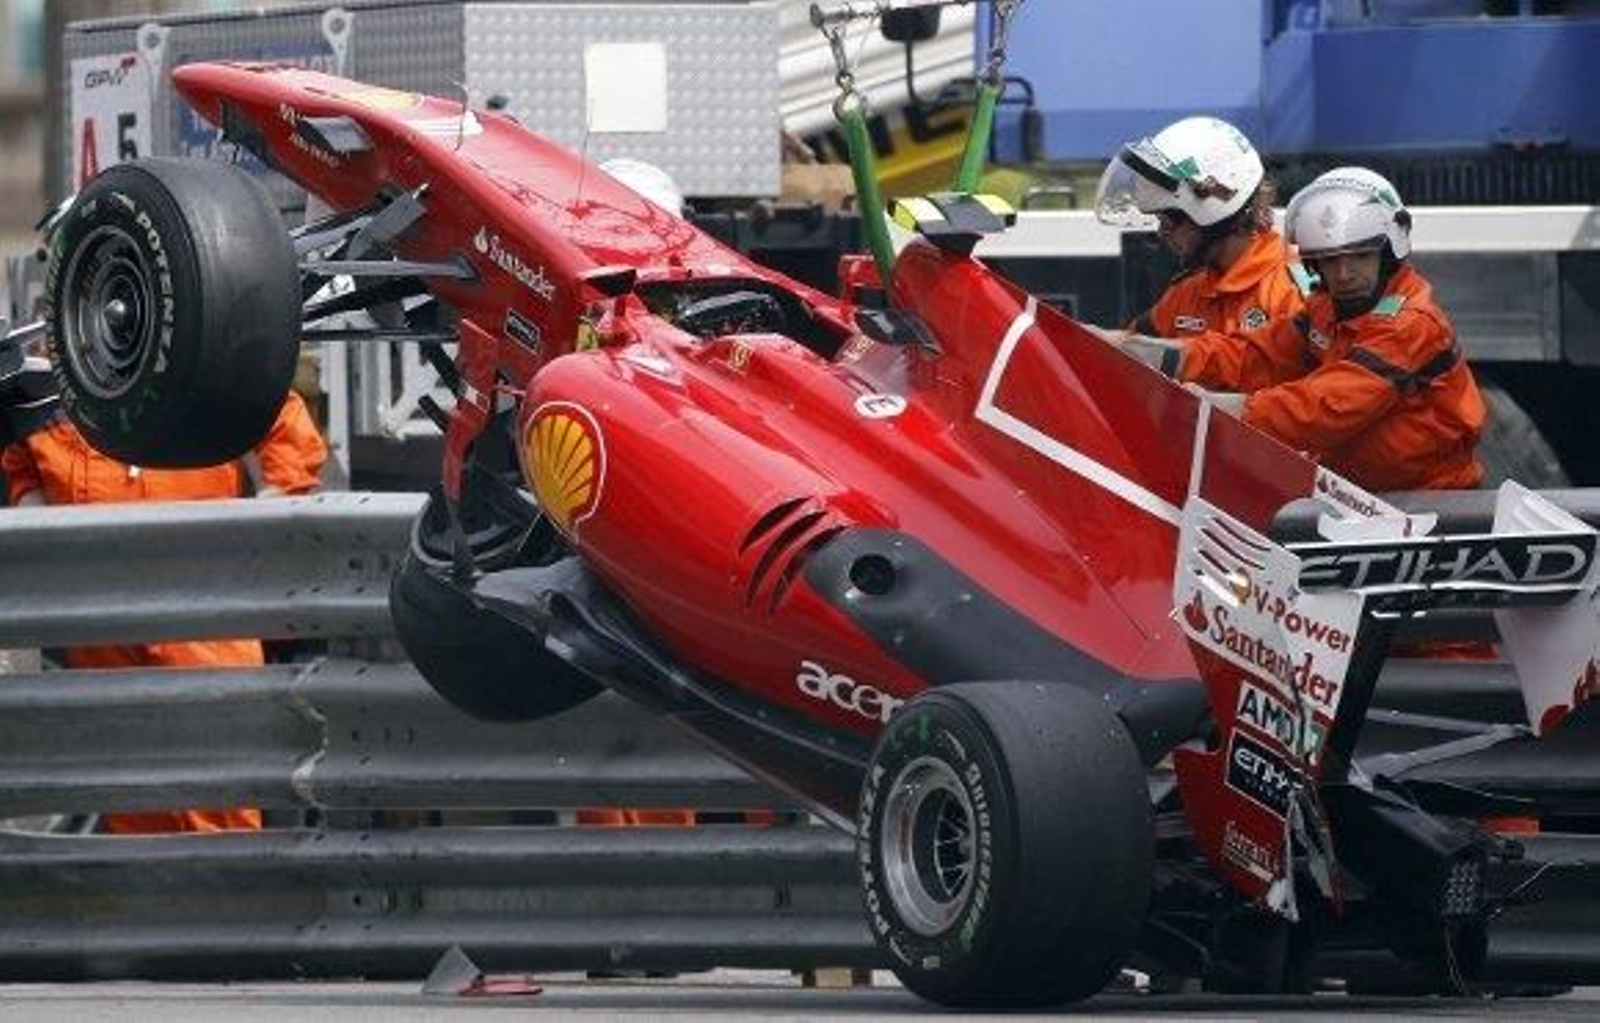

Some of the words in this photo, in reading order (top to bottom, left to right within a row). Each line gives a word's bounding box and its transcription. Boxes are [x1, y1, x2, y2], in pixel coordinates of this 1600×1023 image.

[135, 210, 175, 373] POTENZA
[489, 235, 555, 301] Santander
[1298, 543, 1586, 590] ETIHAD
[1210, 605, 1338, 706] Santander
[796, 661, 904, 724] acer
